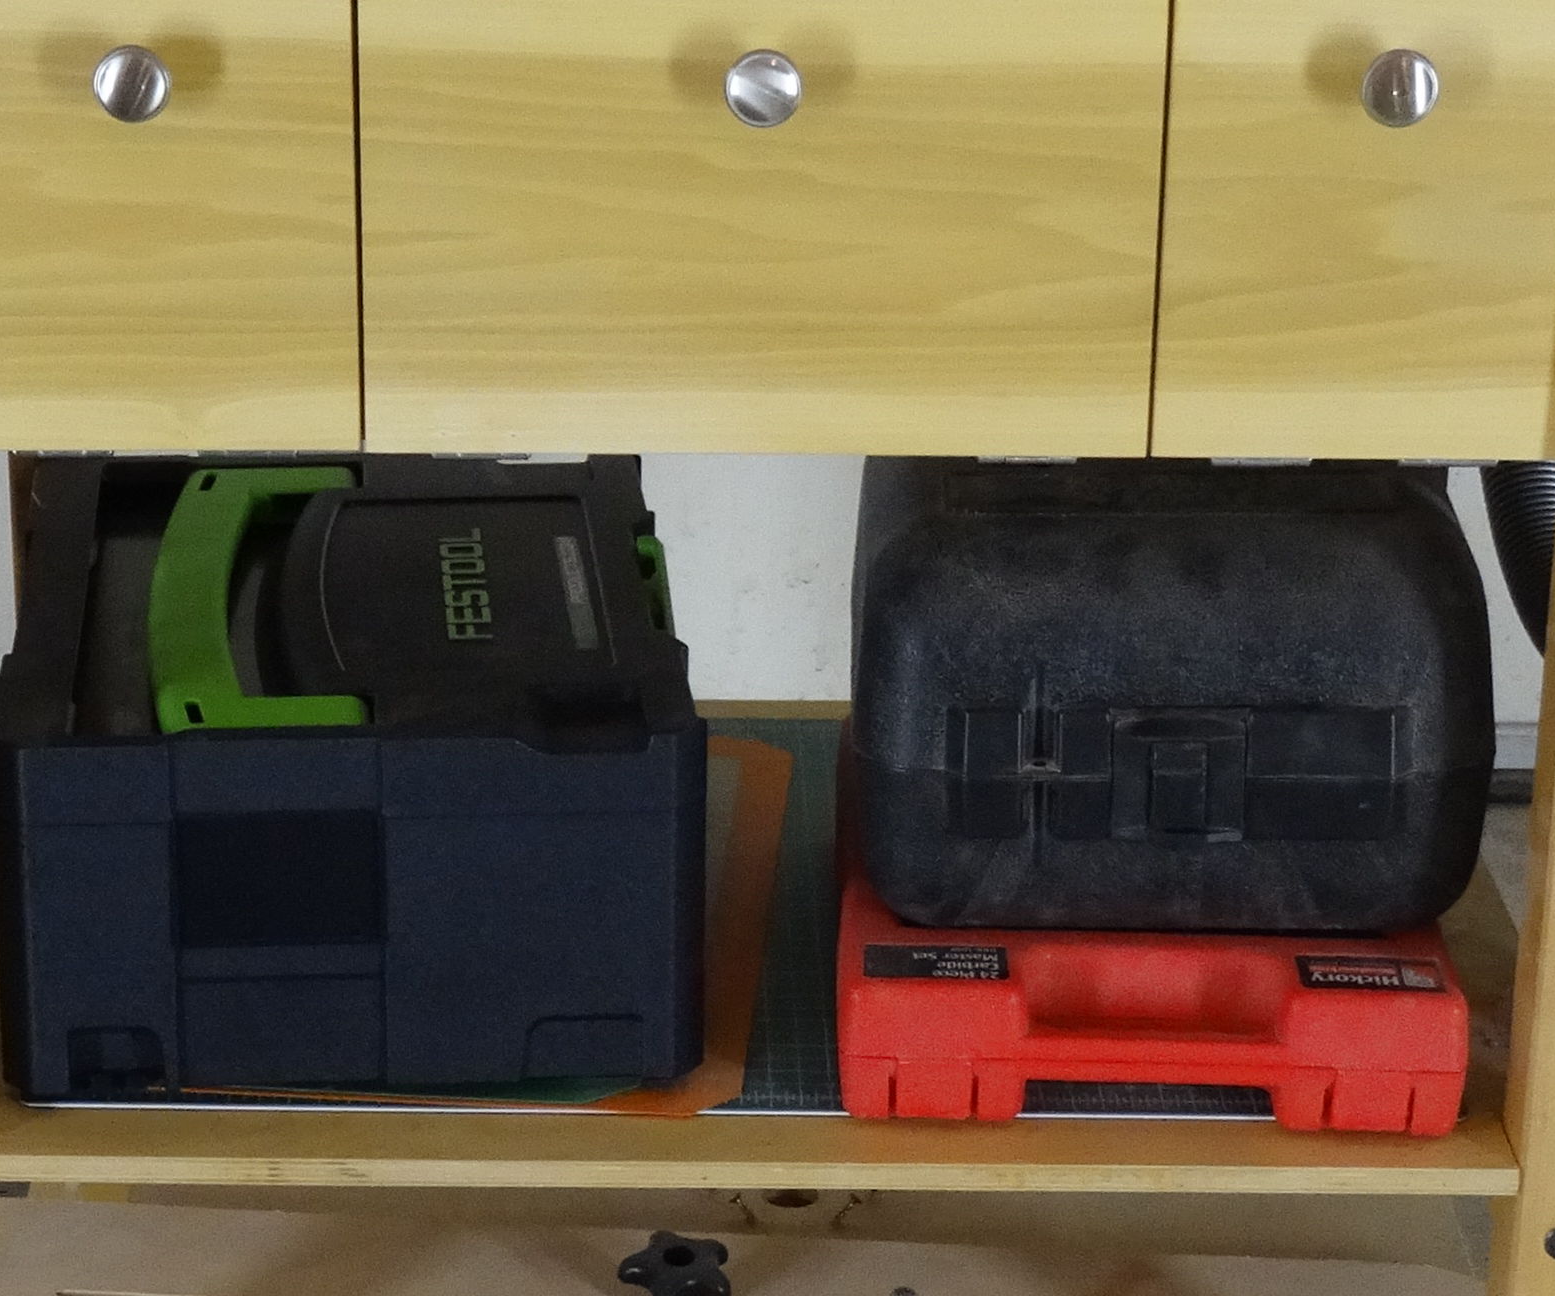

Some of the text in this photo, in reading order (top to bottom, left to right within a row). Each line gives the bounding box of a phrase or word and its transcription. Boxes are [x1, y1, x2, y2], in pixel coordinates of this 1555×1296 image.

[438, 527, 494, 641] FESTOOL
[912, 951, 998, 961] Master Set
[937, 961, 999, 970] Carbide
[932, 969, 975, 980] Piece
[1311, 971, 1400, 986] Hickory
